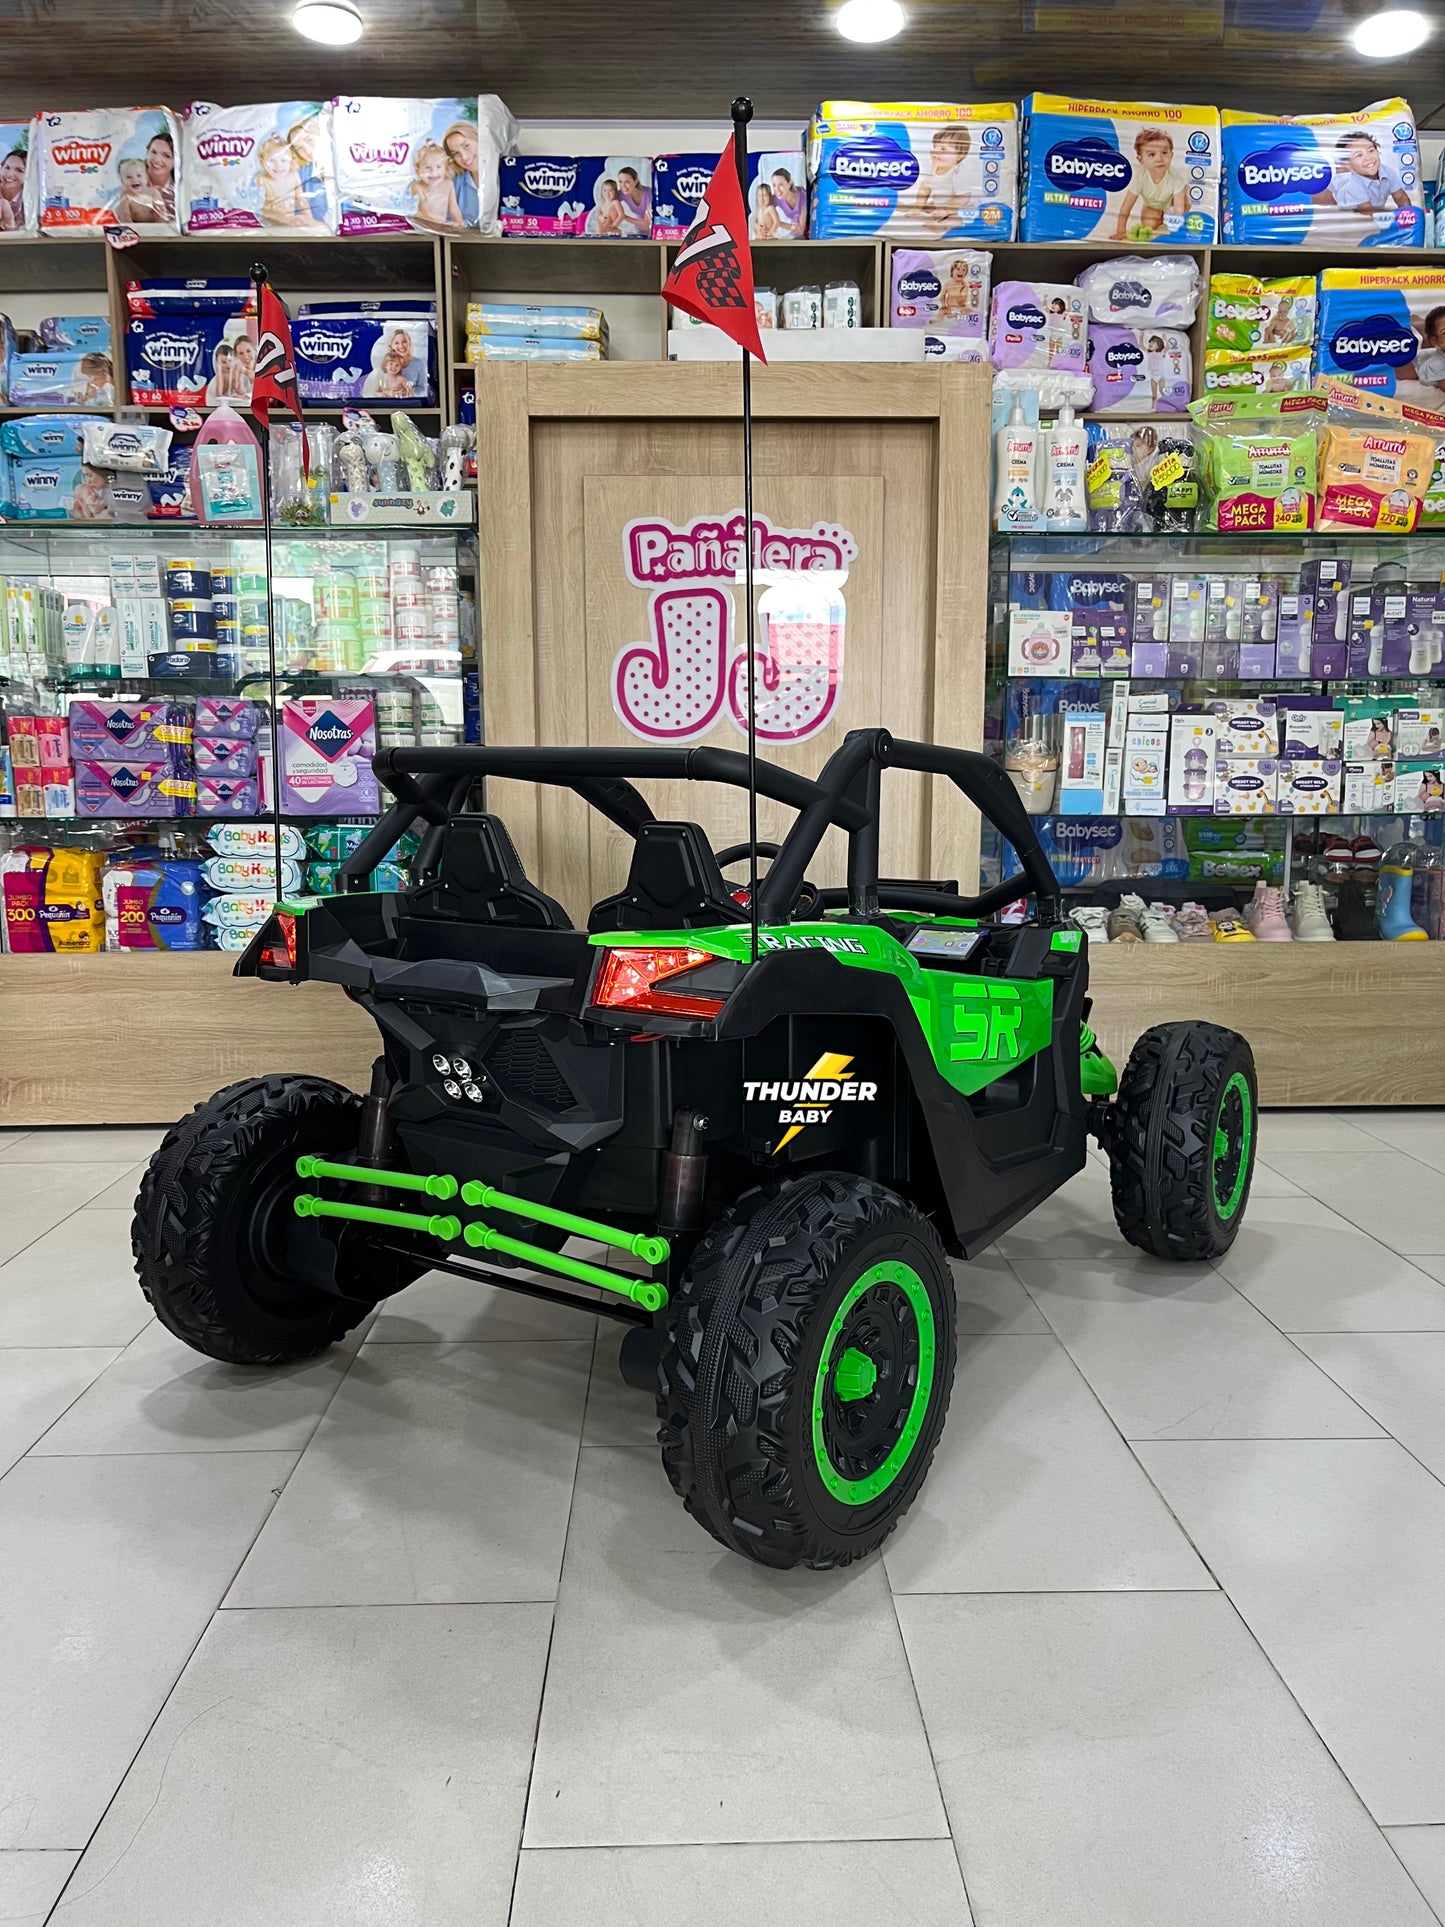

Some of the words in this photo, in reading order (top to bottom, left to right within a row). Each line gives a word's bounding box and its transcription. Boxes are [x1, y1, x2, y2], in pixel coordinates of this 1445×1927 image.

[1164, 110, 1182, 119] 100
[199, 136, 253, 157] winny
[54, 143, 109, 164] winny
[836, 157, 914, 178] Babysec
[1051, 154, 1125, 178] Babysec
[528, 171, 575, 191] winny
[1244, 164, 1324, 185] Babysec
[681, 175, 709, 194] win
[1044, 193, 1069, 202] ULTRA
[1069, 197, 1103, 208] PROTECT
[983, 210, 1000, 221] 2/M
[1242, 205, 1267, 214] ULTRA
[1269, 204, 1305, 215] PROTECT
[527, 218, 538, 226] 50
[900, 280, 938, 293] Babysec
[1360, 276, 1409, 285] HIPERPACK
[1008, 311, 1044, 323] Babysec
[1214, 300, 1270, 321] Bebex
[968, 314, 979, 322] XG
[81, 325, 100, 335] winny
[149, 340, 196, 361] winny
[303, 336, 350, 356] winny
[925, 344, 944, 352] ysec
[1335, 336, 1410, 357] Babysec
[1107, 351, 1141, 364] Babysec
[28, 364, 58, 379] winny
[1205, 371, 1264, 389] Bebex
[1354, 376, 1387, 385] PROTECT
[299, 383, 308, 391] 50
[1284, 398, 1306, 407] MEGA
[1308, 397, 1327, 406] PACK
[1404, 407, 1424, 418] MEGA
[1425, 412, 1444, 421] PACK
[44, 432, 65, 442] winny
[111, 440, 140, 454] winny
[1248, 443, 1291, 458] Arrurrú
[1364, 436, 1406, 455] Arrurrú
[1370, 456, 1396, 465] TOALLITAS
[26, 473, 58, 488] winny
[112, 491, 142, 501] winny
[1336, 495, 1373, 508] MEGA
[1232, 503, 1267, 515] MEGA
[1339, 507, 1369, 519] PACK
[1235, 515, 1266, 526] PACK
[1276, 514, 1291, 522] 240
[1380, 513, 1395, 522] 270
[637, 528, 837, 576] Pañalera
[1072, 579, 1126, 596] Babysec
[1412, 595, 1436, 603] Natural
[1058, 699, 1099, 713] Babys
[106, 719, 136, 730] Nosotras
[309, 725, 354, 741] Nosotras
[296, 767, 328, 775] seguridad
[110, 777, 139, 788] Nosotras
[165, 781, 191, 790] OFERTA
[289, 776, 302, 785] 40
[1056, 822, 1116, 840] Babysec
[224, 830, 256, 845] Baby
[257, 830, 291, 846] Ka's
[1071, 856, 1101, 864] PROTECT
[218, 862, 249, 877] Baby
[1203, 860, 1264, 879] Bebex
[222, 899, 254, 915] Baby
[7, 907, 36, 922] 300
[39, 909, 71, 921] Pequeñín
[120, 910, 145, 923] 200
[150, 912, 182, 923] Pequeñín
[229, 929, 256, 940] Bab
[758, 935, 869, 956] RACING
[950, 981, 1025, 1064] SR
